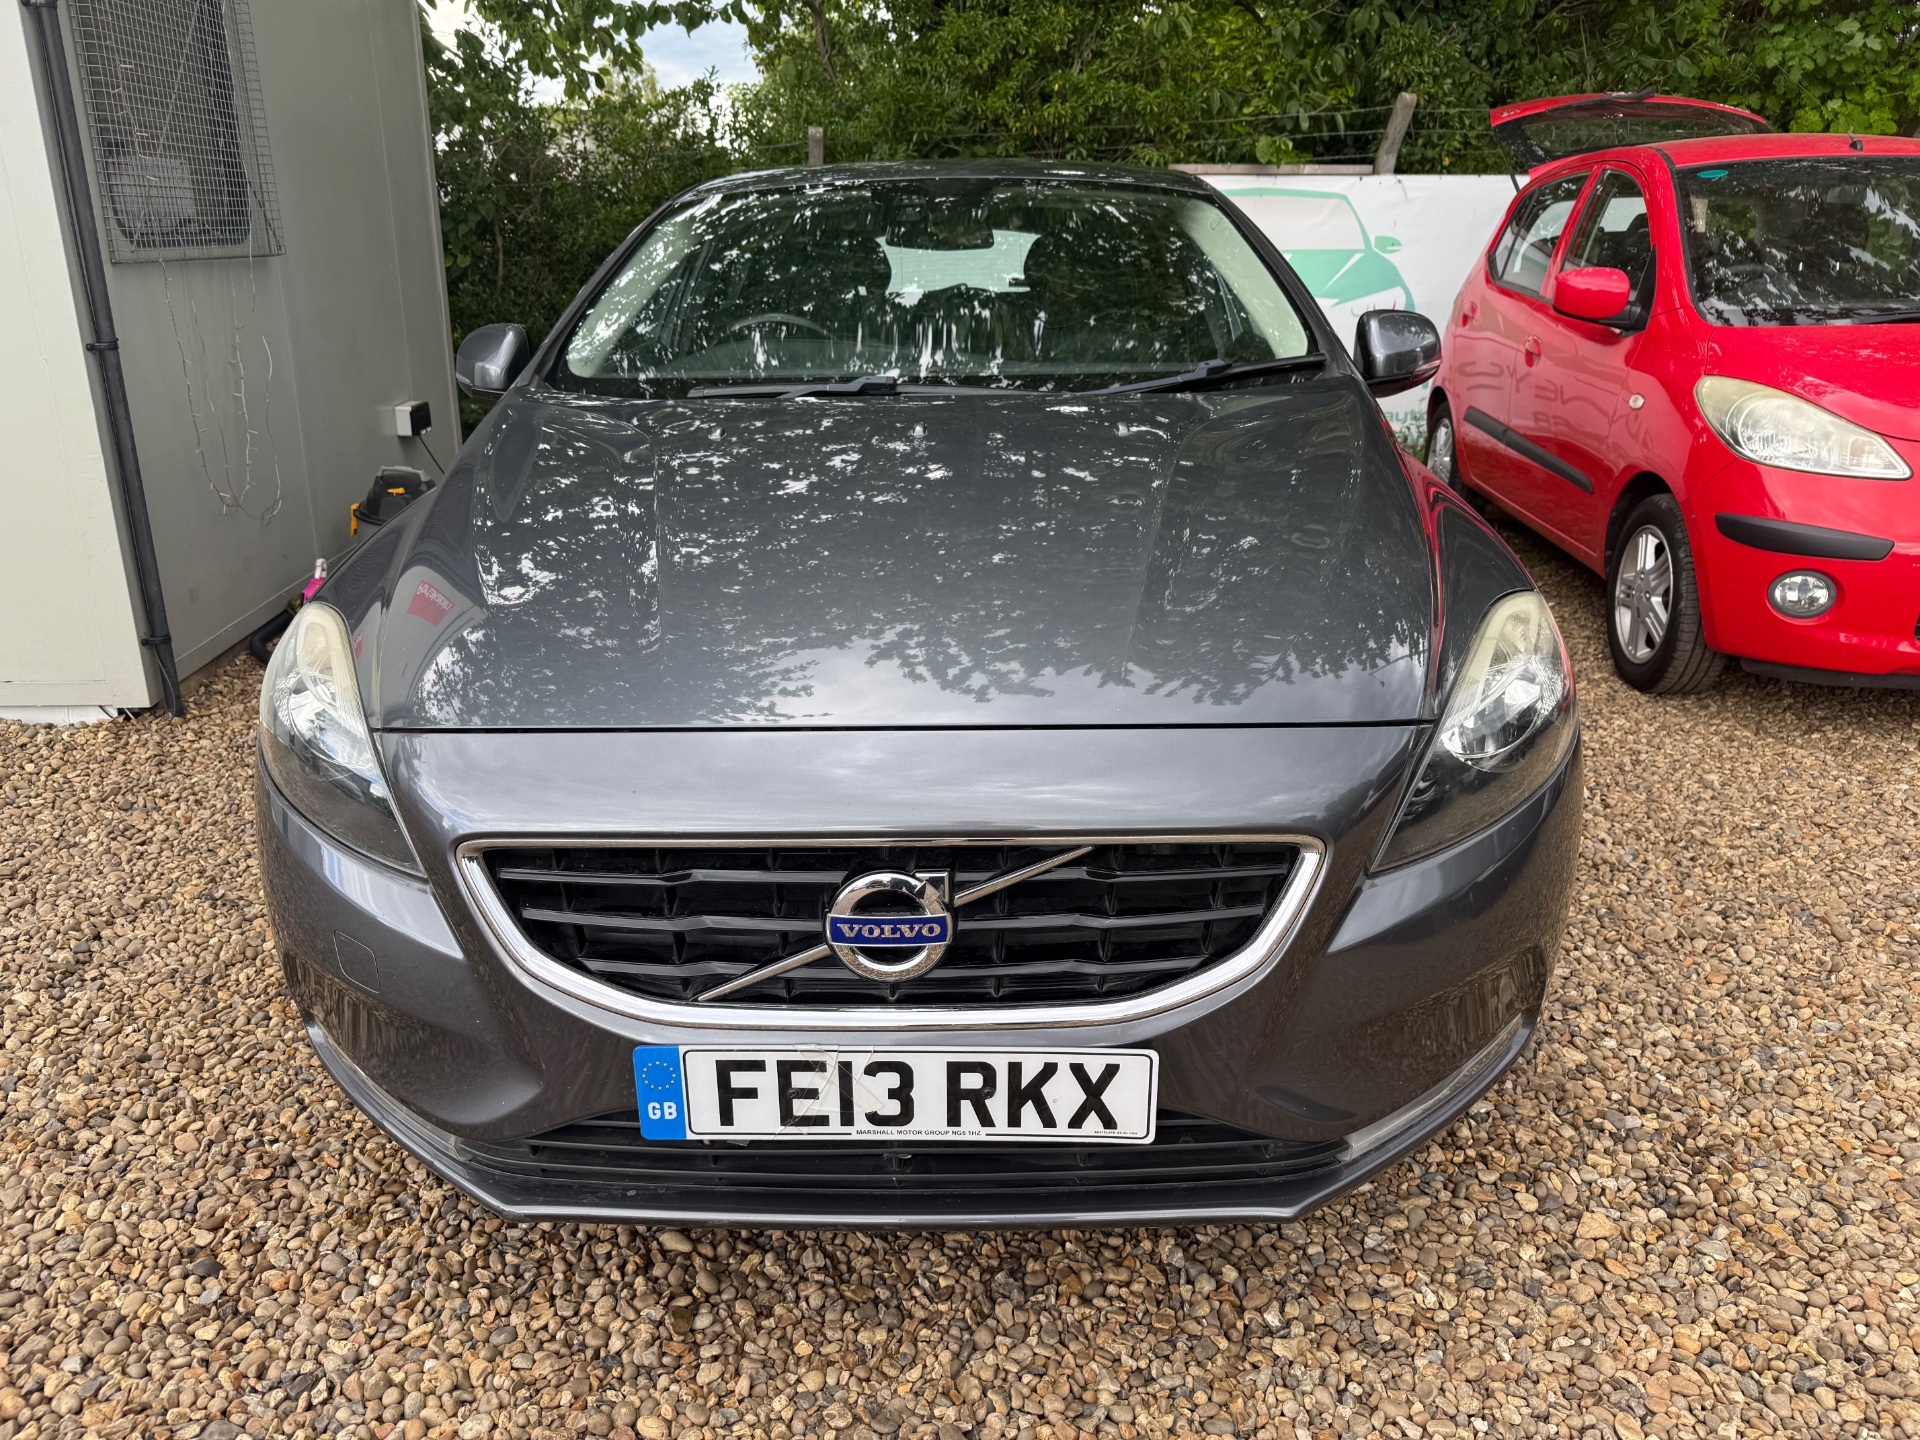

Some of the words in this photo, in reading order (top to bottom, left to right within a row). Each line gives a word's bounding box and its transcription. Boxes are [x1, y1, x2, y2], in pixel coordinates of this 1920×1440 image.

[836, 923, 941, 938] VOLVO
[715, 1059, 915, 1127] FE13
[946, 1060, 1121, 1130] RKX
[647, 1101, 678, 1120] GB
